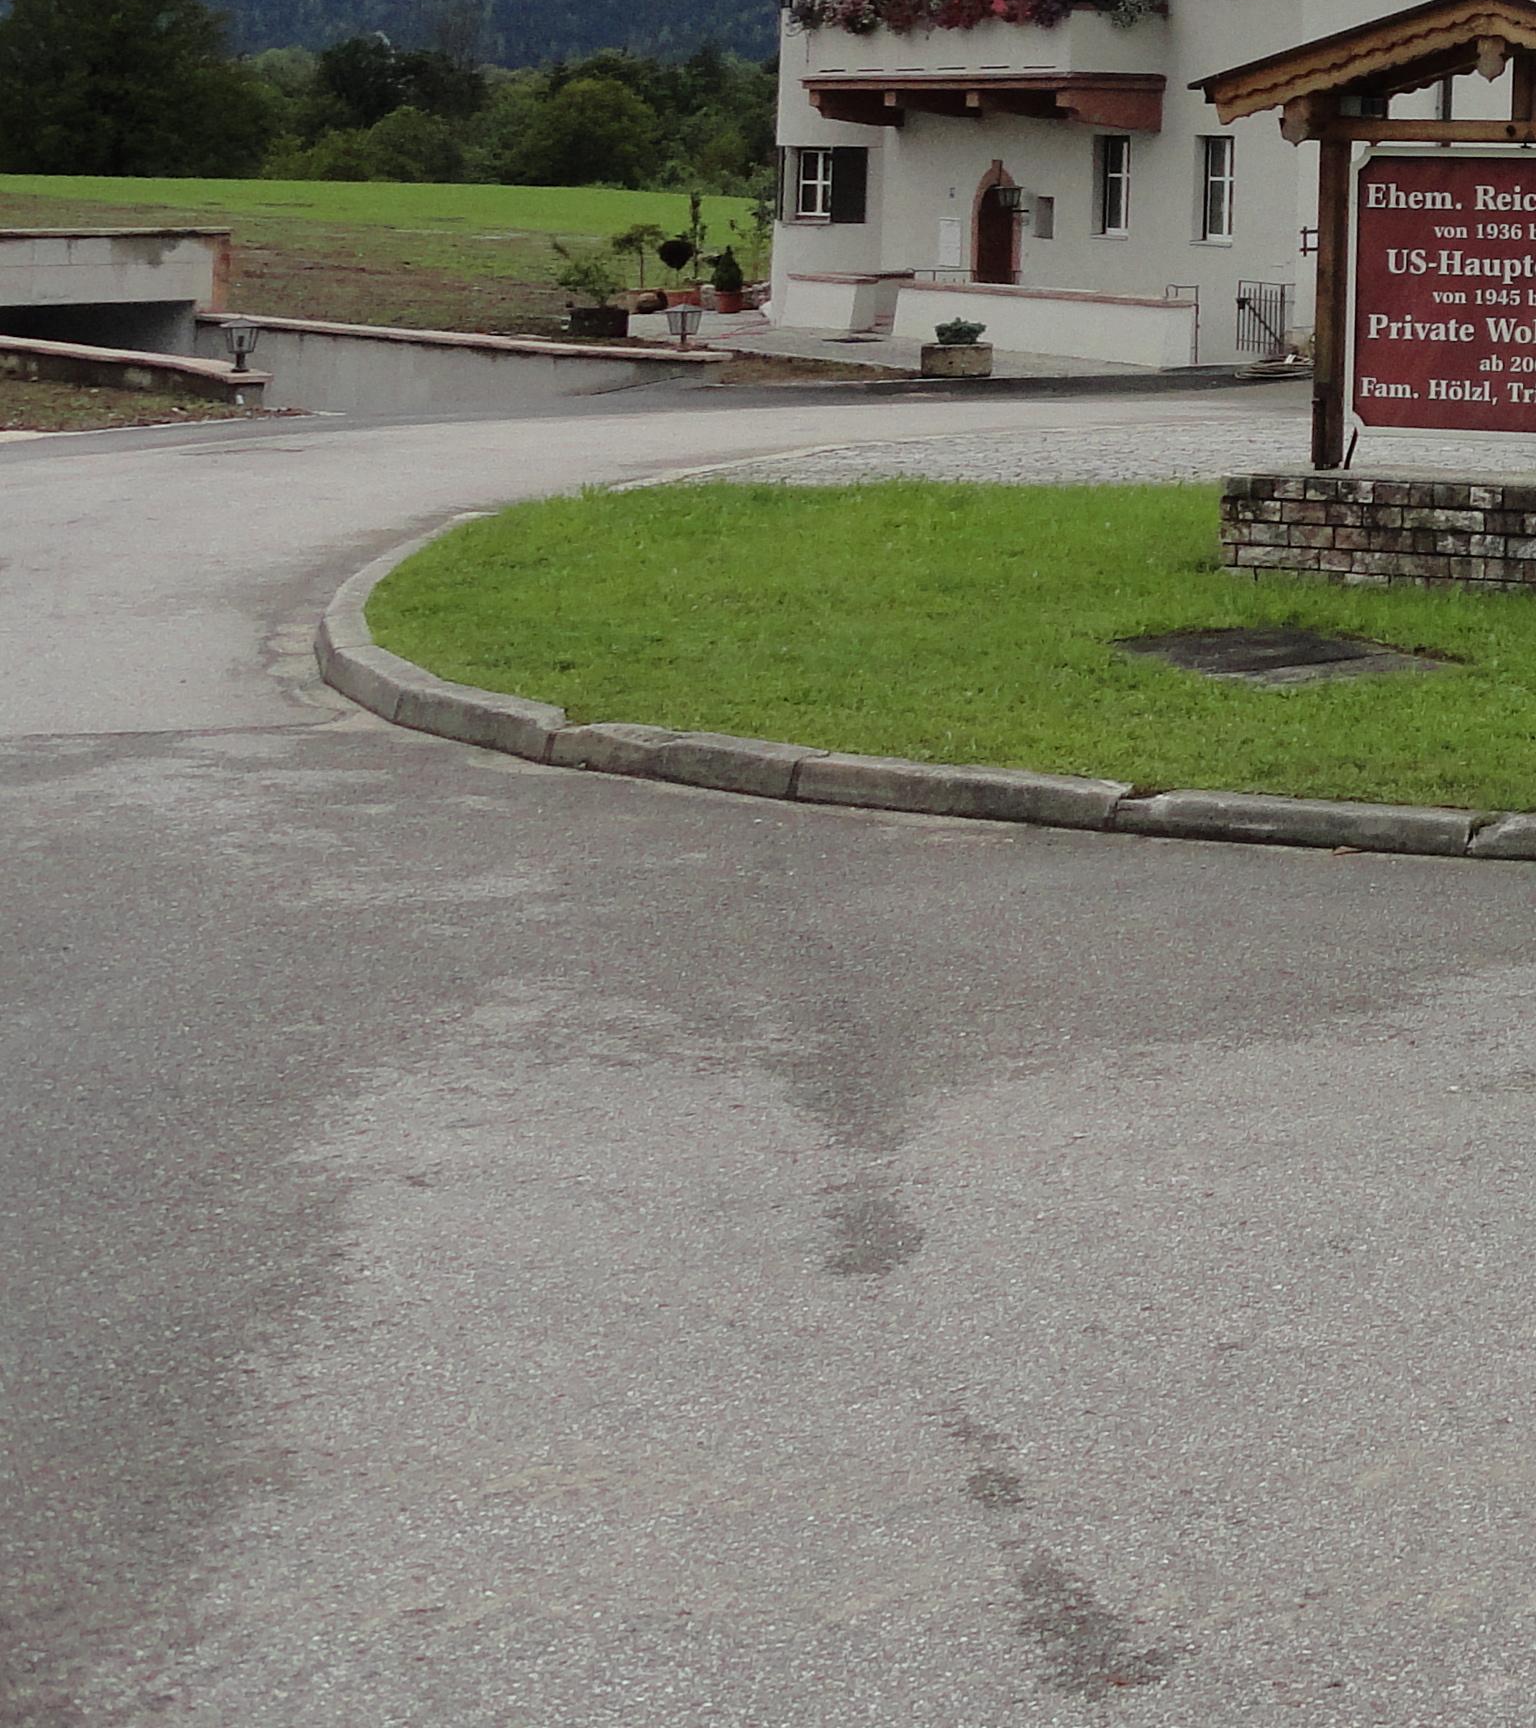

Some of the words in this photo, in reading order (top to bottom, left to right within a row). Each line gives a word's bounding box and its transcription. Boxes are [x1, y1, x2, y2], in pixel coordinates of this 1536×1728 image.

[1366, 183, 1463, 210] Ehem.
[1434, 225, 1468, 240] von
[1475, 224, 1522, 240] 1936
[1433, 290, 1467, 305] von
[1474, 289, 1521, 306] 1945
[1367, 314, 1475, 343] Private
[1479, 355, 1504, 372] ab
[1360, 377, 1419, 399] Fam.
[1427, 379, 1498, 405] Hölzl,
